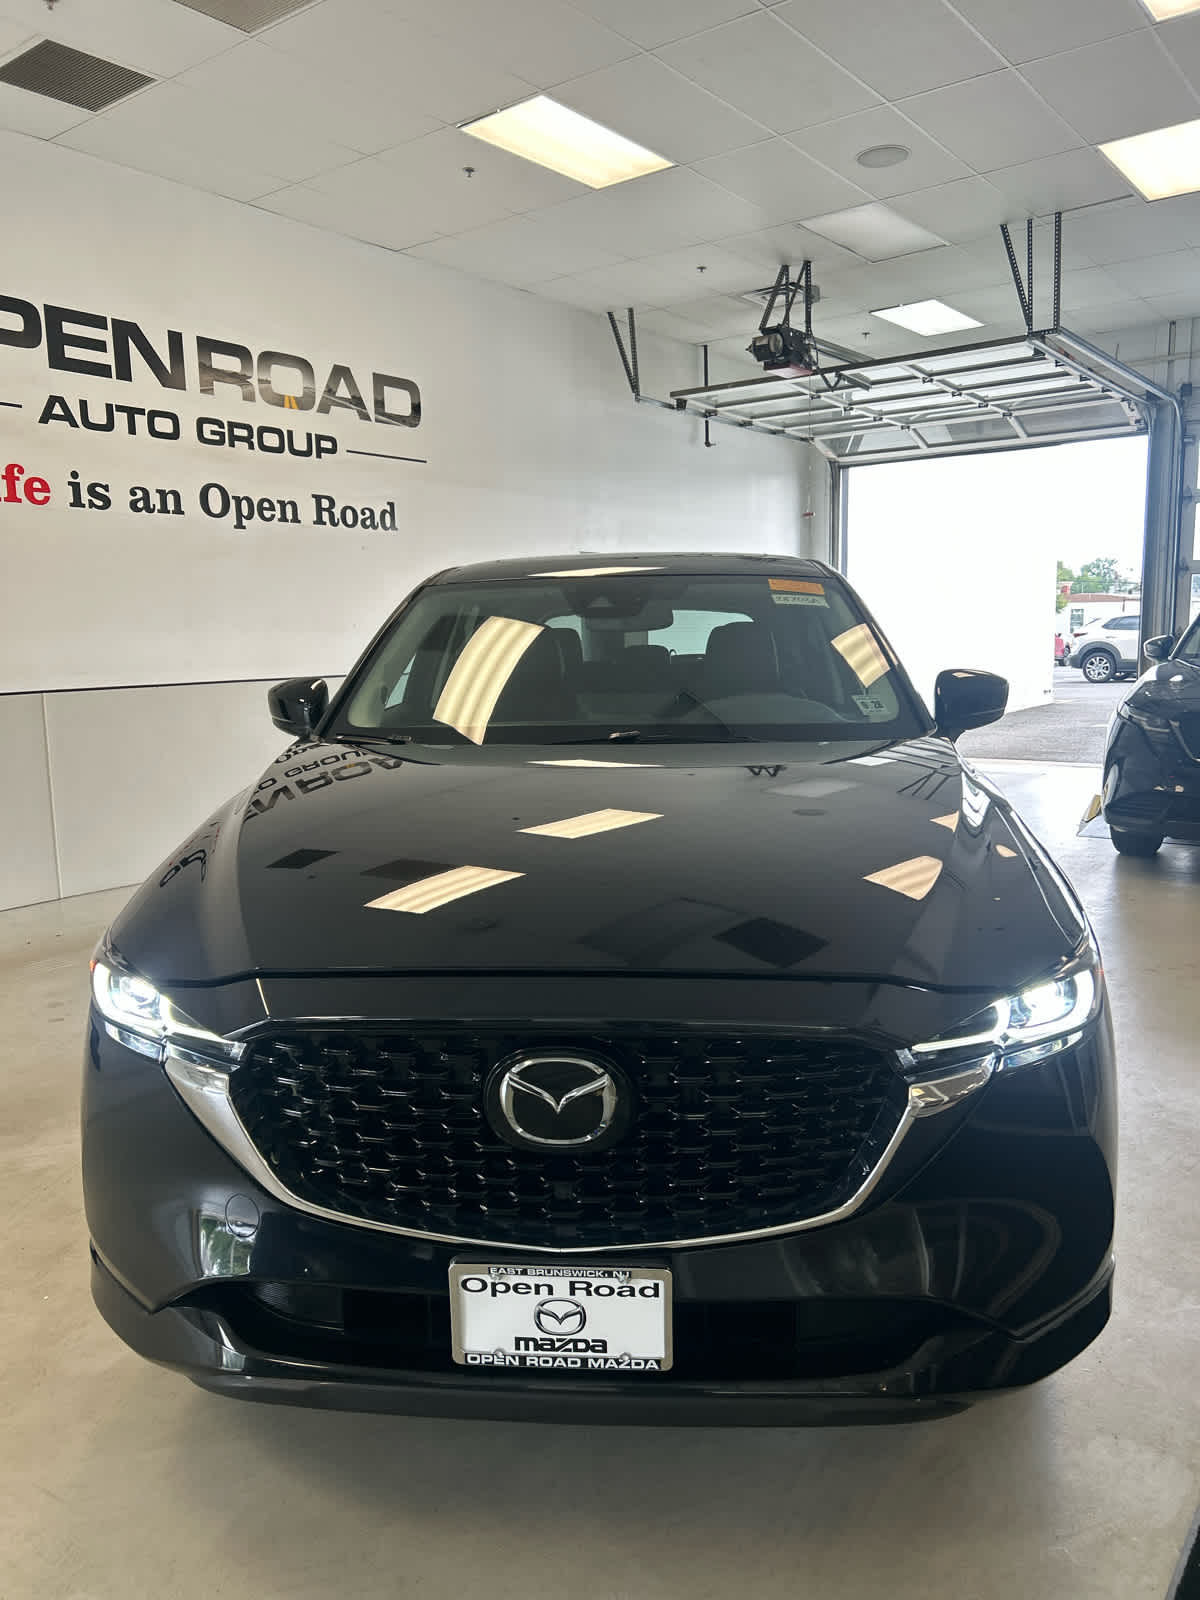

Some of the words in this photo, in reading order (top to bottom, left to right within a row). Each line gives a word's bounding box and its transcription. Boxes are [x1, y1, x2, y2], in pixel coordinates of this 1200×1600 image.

[195, 334, 422, 429] ROAD
[38, 394, 181, 441] AUTO
[196, 416, 338, 459] GROUP
[0, 463, 51, 506] fe
[67, 470, 112, 511] is
[129, 483, 185, 516] an
[200, 482, 302, 530] Open
[311, 493, 399, 532] Road
[490, 1267, 523, 1275] EAST
[612, 1270, 630, 1279] NJ
[461, 1277, 554, 1297] Open
[568, 1280, 660, 1298] Road
[514, 1336, 608, 1354] mazda
[466, 1353, 520, 1366] OPEN
[526, 1355, 581, 1368] ROAD
[587, 1357, 660, 1370] MAZDA
